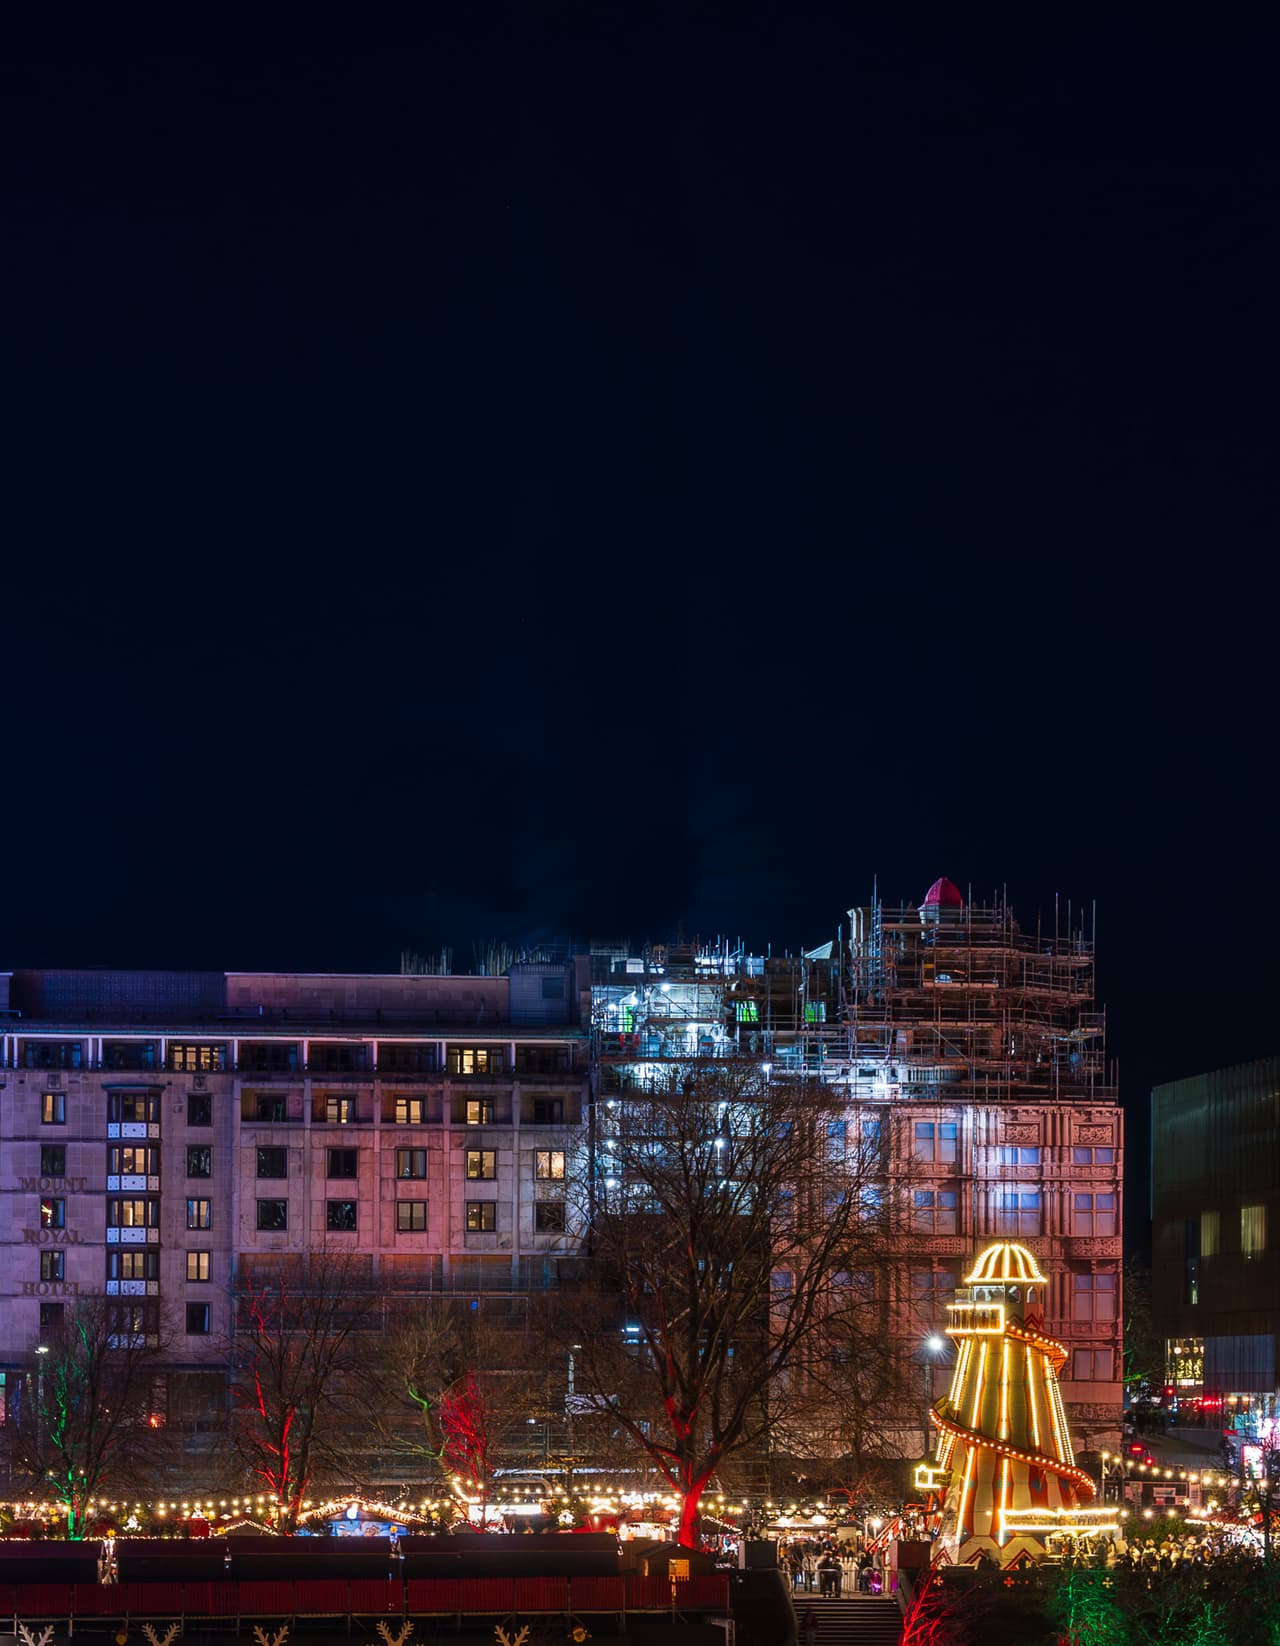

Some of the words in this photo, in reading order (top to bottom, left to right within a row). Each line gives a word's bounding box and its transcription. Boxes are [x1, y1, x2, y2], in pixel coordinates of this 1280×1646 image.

[19, 1177, 87, 1193] MOUNT
[22, 1229, 84, 1244] ROYAL
[22, 1281, 81, 1296] HOTEL
